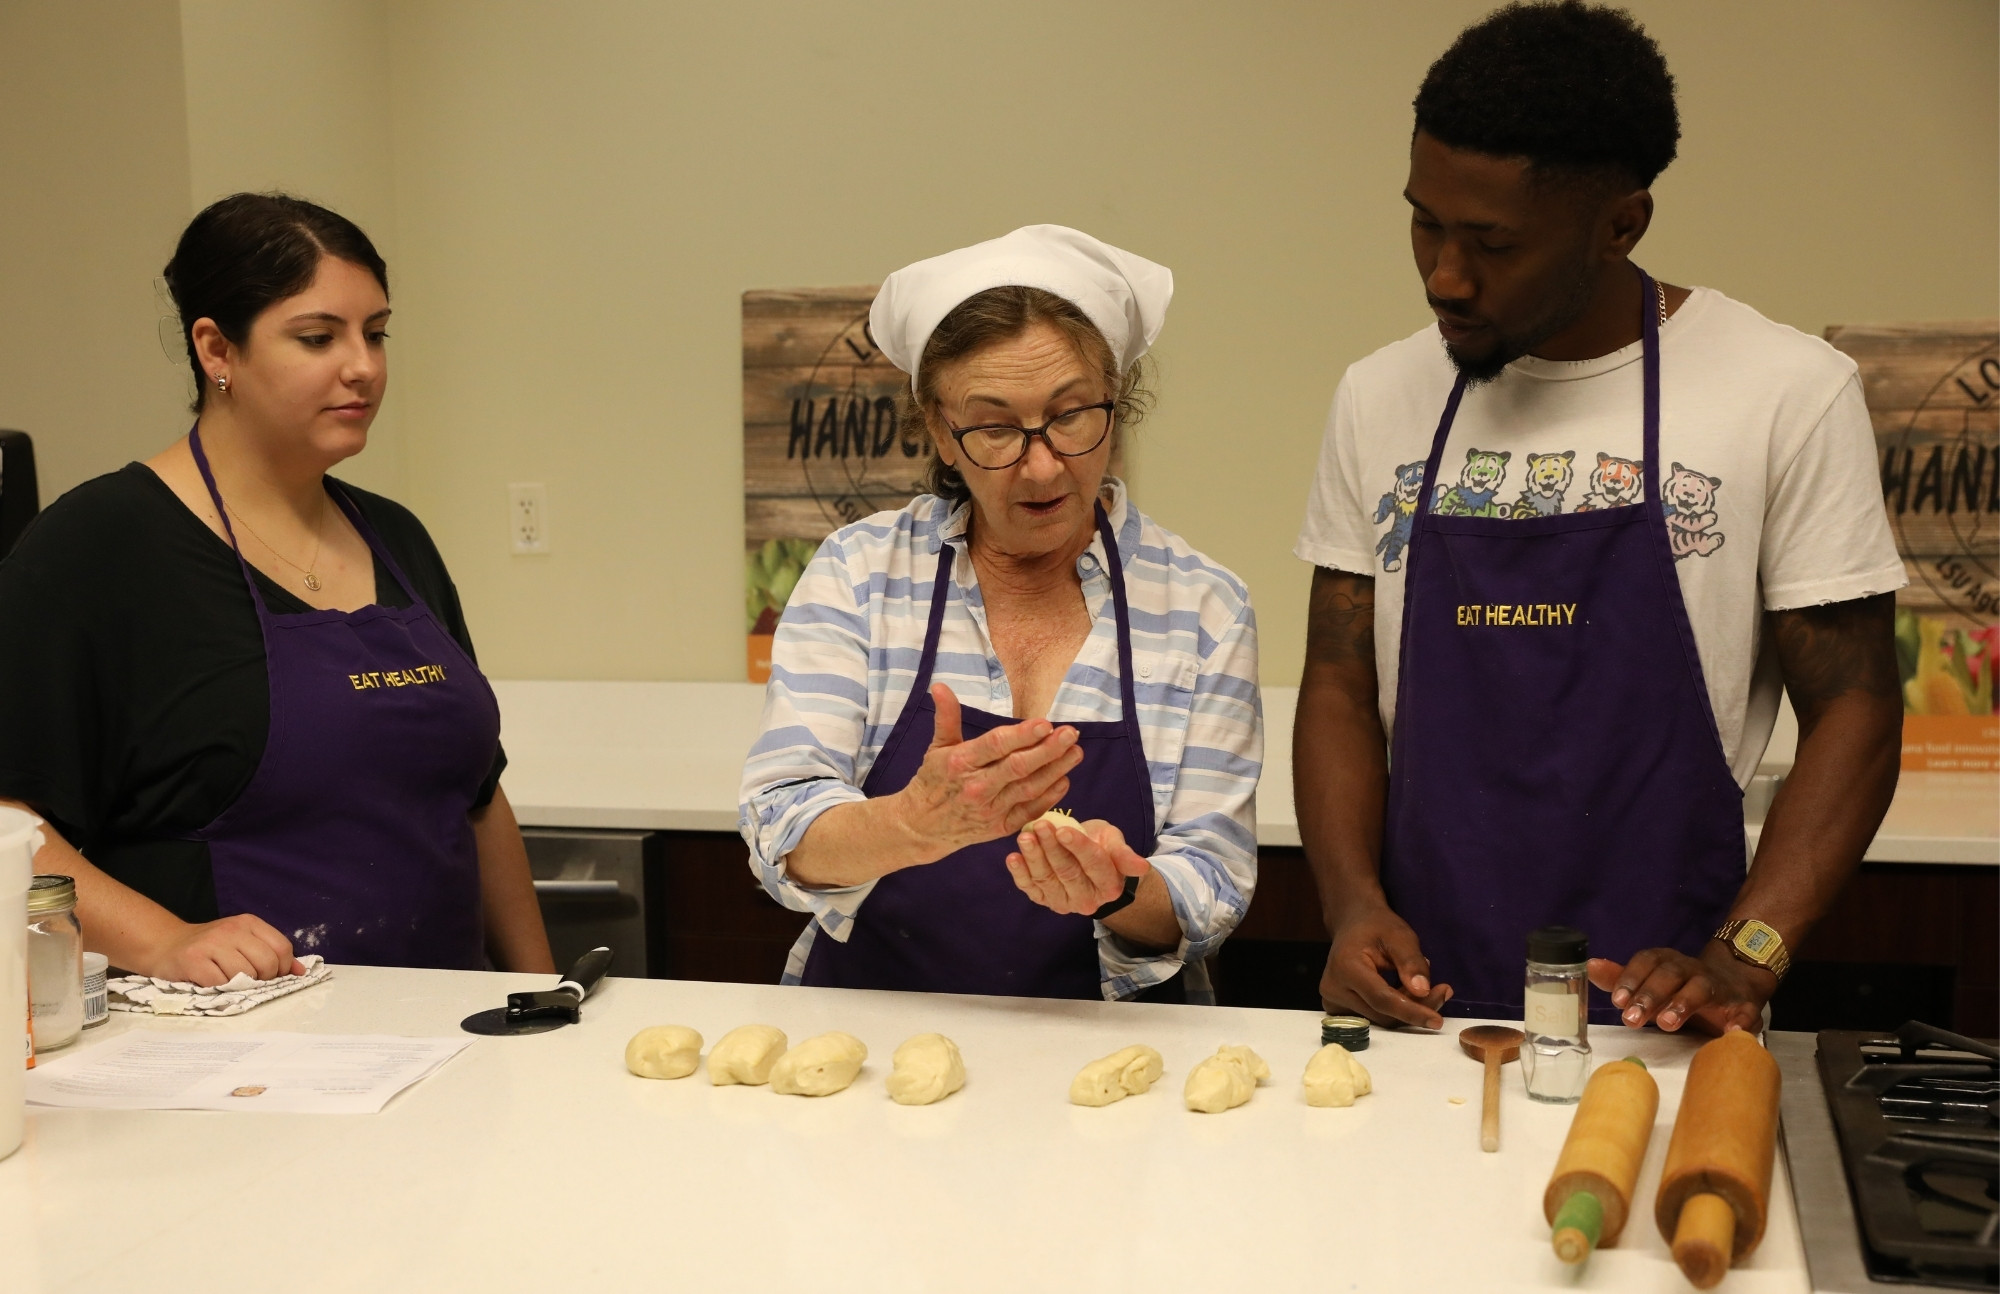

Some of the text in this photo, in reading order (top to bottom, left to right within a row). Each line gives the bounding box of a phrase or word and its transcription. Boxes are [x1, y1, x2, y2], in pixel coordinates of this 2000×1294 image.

[1935, 554, 1972, 589] LSU
[1457, 603, 1577, 626] EAT HEALTHY
[348, 664, 447, 690] EAT HEALTHY
